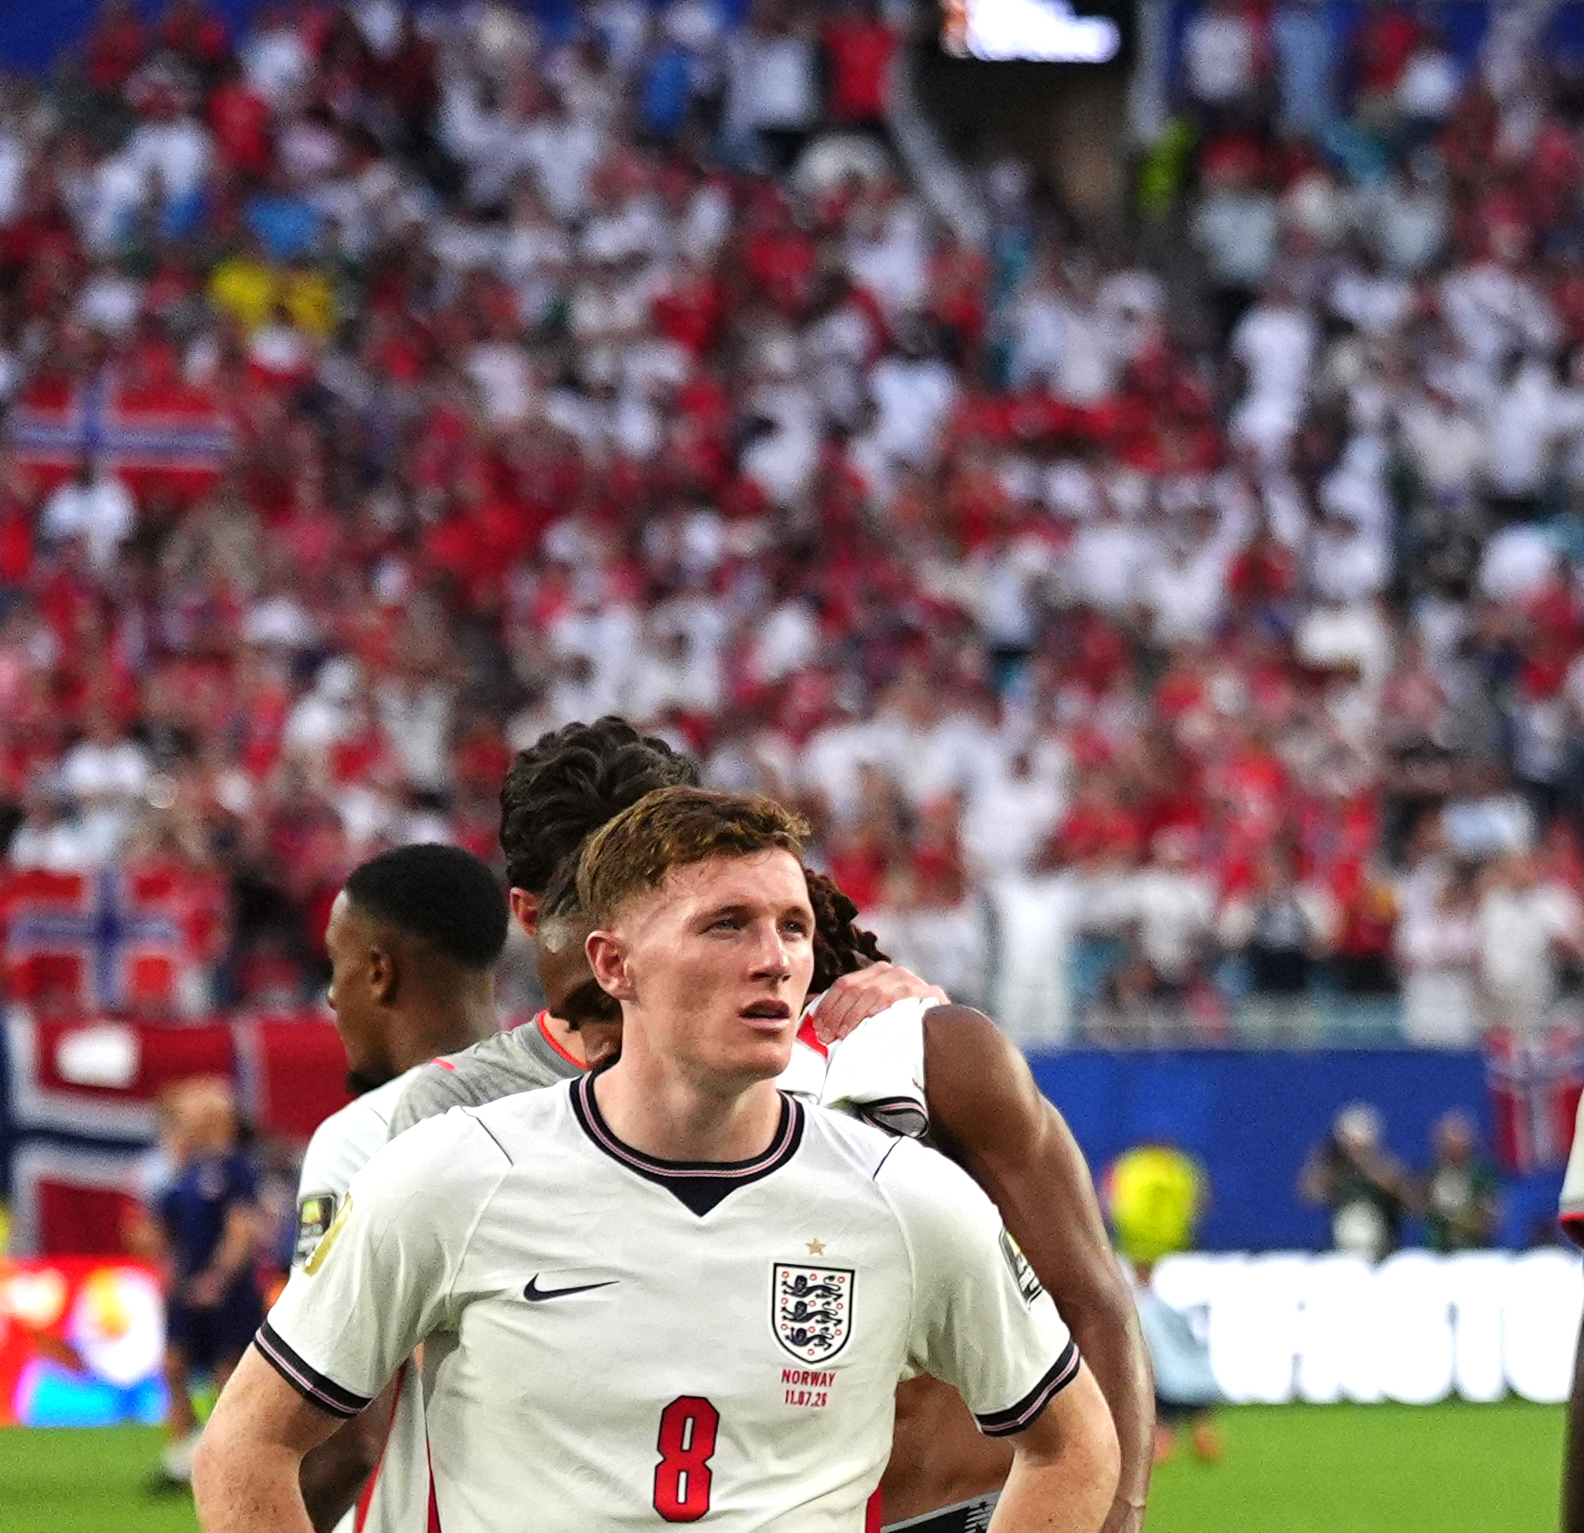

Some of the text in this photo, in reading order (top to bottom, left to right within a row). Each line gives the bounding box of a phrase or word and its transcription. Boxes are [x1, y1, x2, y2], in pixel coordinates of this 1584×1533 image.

[781, 1368, 836, 1387] NORWAY
[784, 1389, 828, 1407] 11.07.26
[653, 1394, 720, 1523] 8
